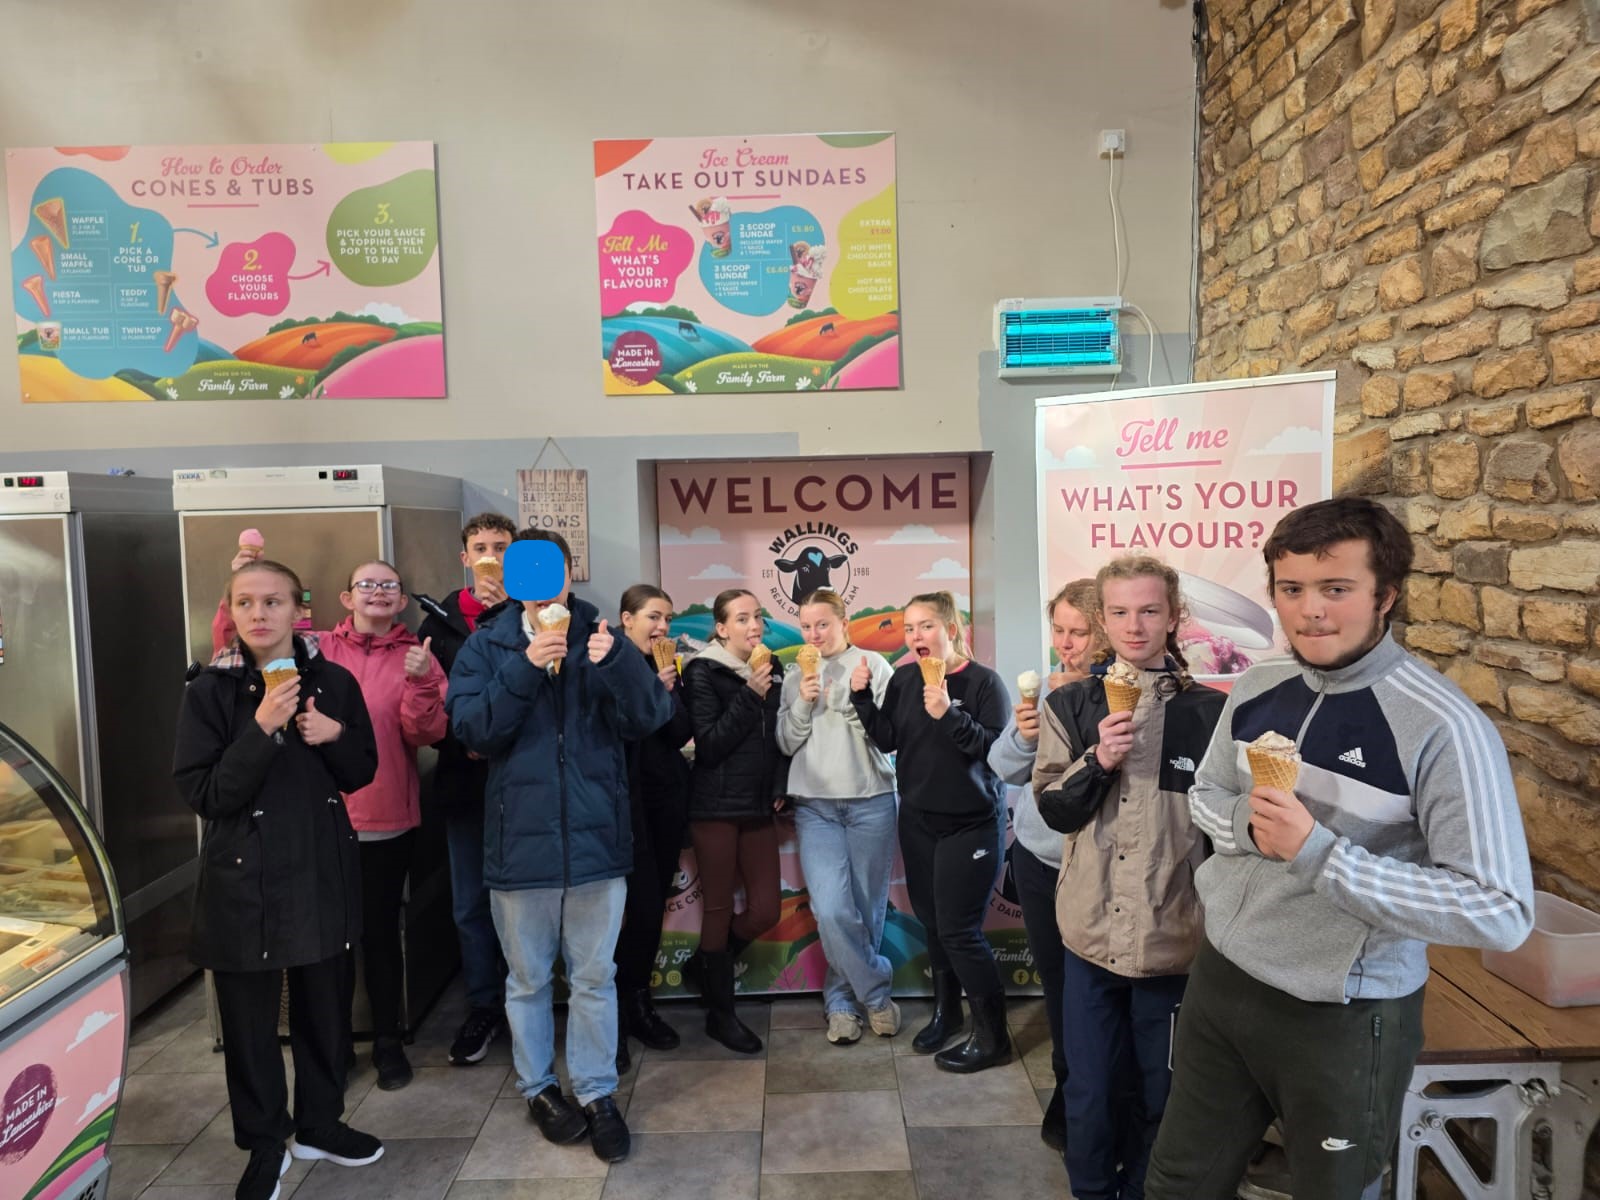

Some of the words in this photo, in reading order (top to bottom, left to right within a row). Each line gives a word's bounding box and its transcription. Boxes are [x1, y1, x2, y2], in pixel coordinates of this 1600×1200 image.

[162, 157, 202, 176] How
[209, 156, 224, 175] to
[231, 156, 283, 176] Order
[700, 149, 728, 168] Ice
[736, 148, 789, 167] Cream
[132, 179, 216, 196] CONES
[227, 179, 241, 195] &
[252, 179, 314, 195] TUBS
[623, 173, 684, 190] TAKE
[694, 171, 744, 188] OUT
[755, 168, 866, 186] SUNDAES
[374, 203, 394, 224] 3.
[130, 222, 143, 244] 1.
[394, 228, 425, 236] SAUCE
[603, 235, 634, 254] Tell
[638, 235, 668, 252] Me
[242, 250, 262, 270] 2.
[611, 255, 660, 265] WHAT'S
[618, 267, 654, 277] YOUR
[604, 278, 669, 289] FLAVOUR?
[228, 292, 279, 300] FLAVOURS
[612, 357, 660, 368] Lancashire
[198, 378, 235, 394] Family
[239, 378, 268, 392] Farm
[716, 372, 753, 387] Family
[756, 371, 786, 384] Farm
[1116, 417, 1179, 457] Tell
[1186, 428, 1229, 450] me
[670, 472, 957, 515] WELCOME
[1061, 484, 1183, 512] WHAT'S
[1194, 480, 1298, 509] YOUR
[528, 515, 581, 528] COWS
[769, 521, 858, 554] WALLINGS
[1092, 520, 1264, 548] FLAVOUR?
[762, 569, 773, 578] EST
[770, 587, 786, 609] REAL
[844, 586, 859, 605] EAM
[997, 904, 1022, 919] DAIR
[991, 948, 1034, 967] Family
[6, 1094, 35, 1124] MADE
[37, 1086, 47, 1100] IN
[0, 1096, 54, 1148] Lancashire
